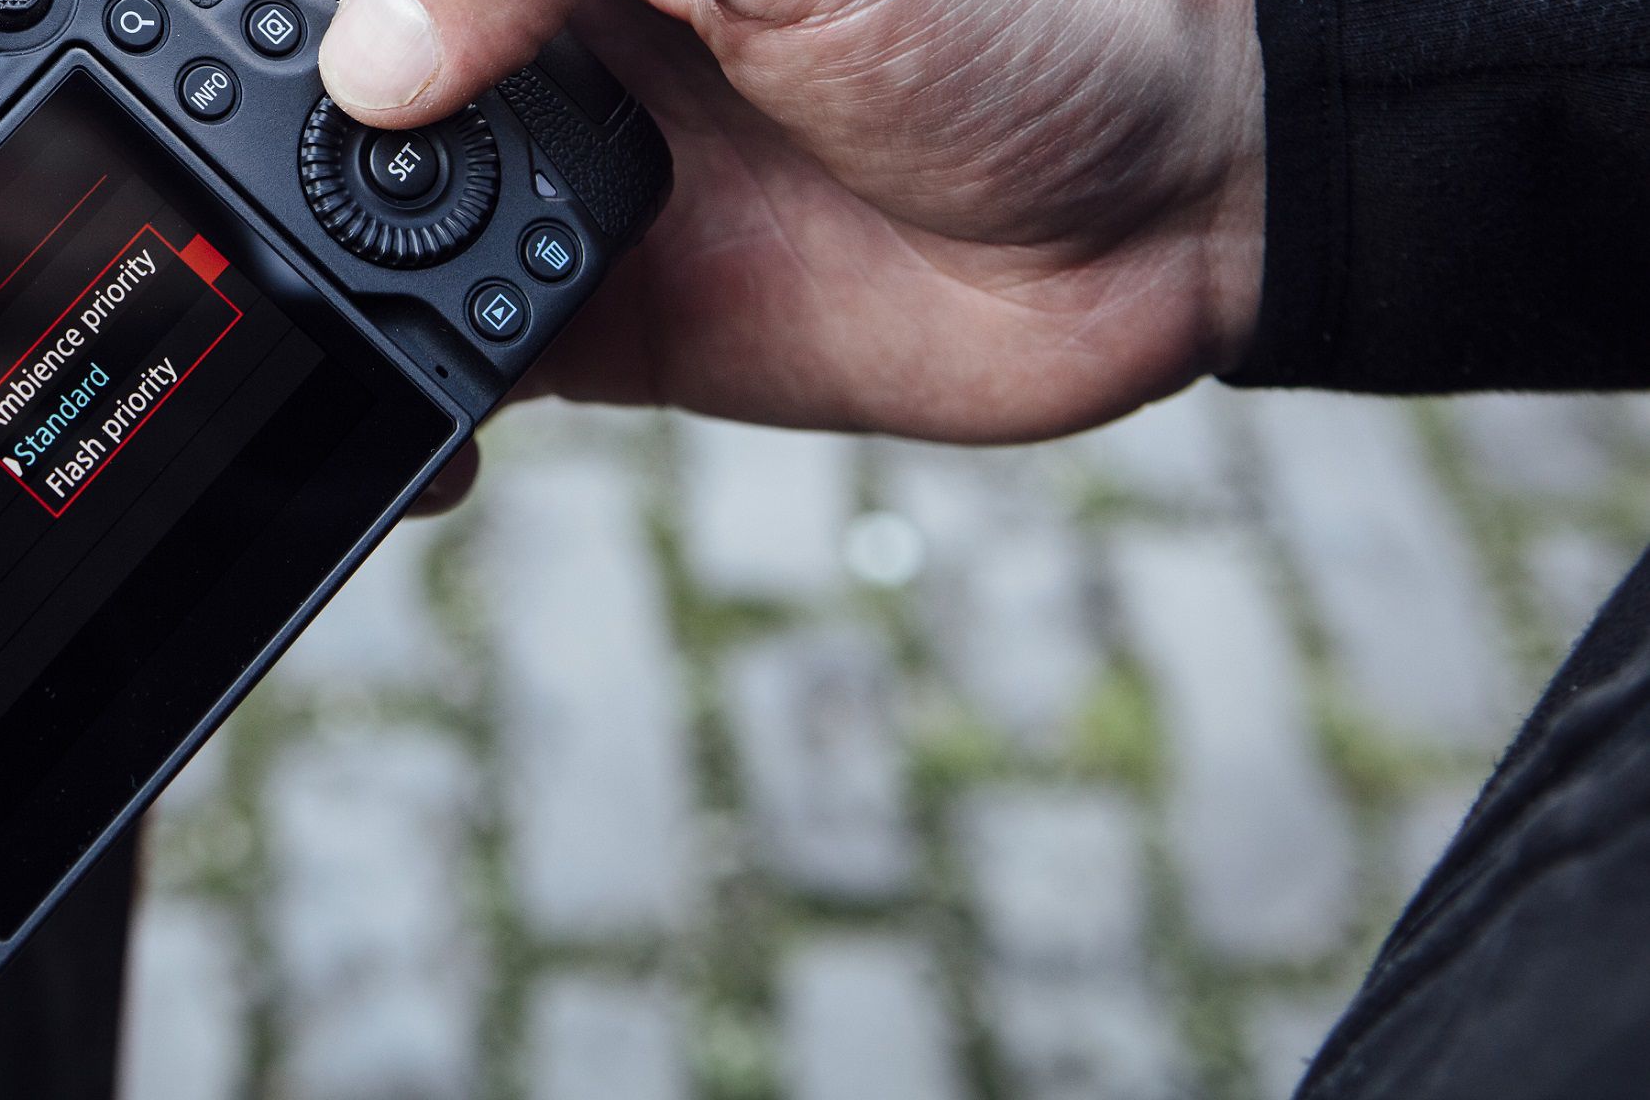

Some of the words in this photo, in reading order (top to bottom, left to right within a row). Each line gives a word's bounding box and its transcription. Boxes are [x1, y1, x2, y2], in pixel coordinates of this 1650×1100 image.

[190, 71, 229, 110] INFO
[387, 143, 422, 183] SET
[81, 247, 157, 332] priority
[14, 363, 110, 466] Standard
[45, 435, 106, 500] Flash
[102, 357, 179, 441] priority
